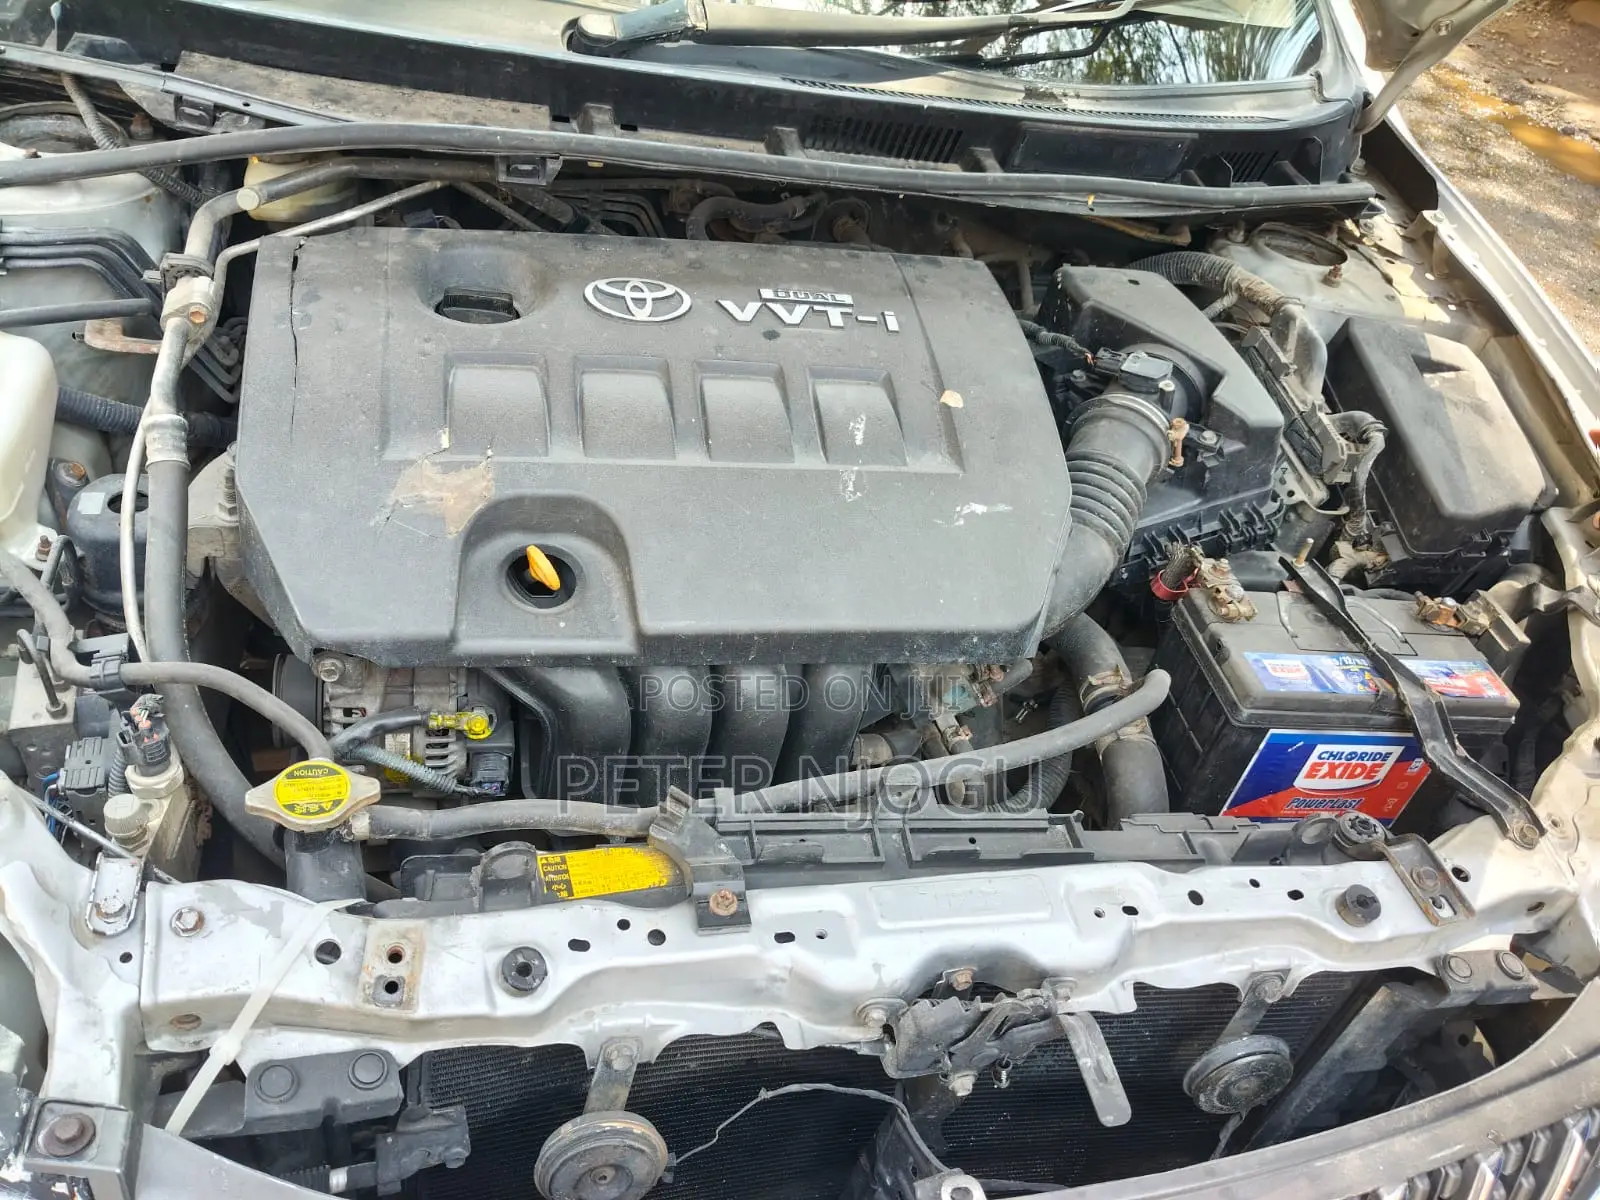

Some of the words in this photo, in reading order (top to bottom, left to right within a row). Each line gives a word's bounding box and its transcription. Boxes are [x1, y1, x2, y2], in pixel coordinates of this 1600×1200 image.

[773, 289, 848, 303] DUAL
[1316, 750, 1393, 761] CHLORIDE
[293, 767, 329, 777] CAUTION
[1303, 762, 1386, 780] EXIDE
[543, 864, 567, 872] CAUTION
